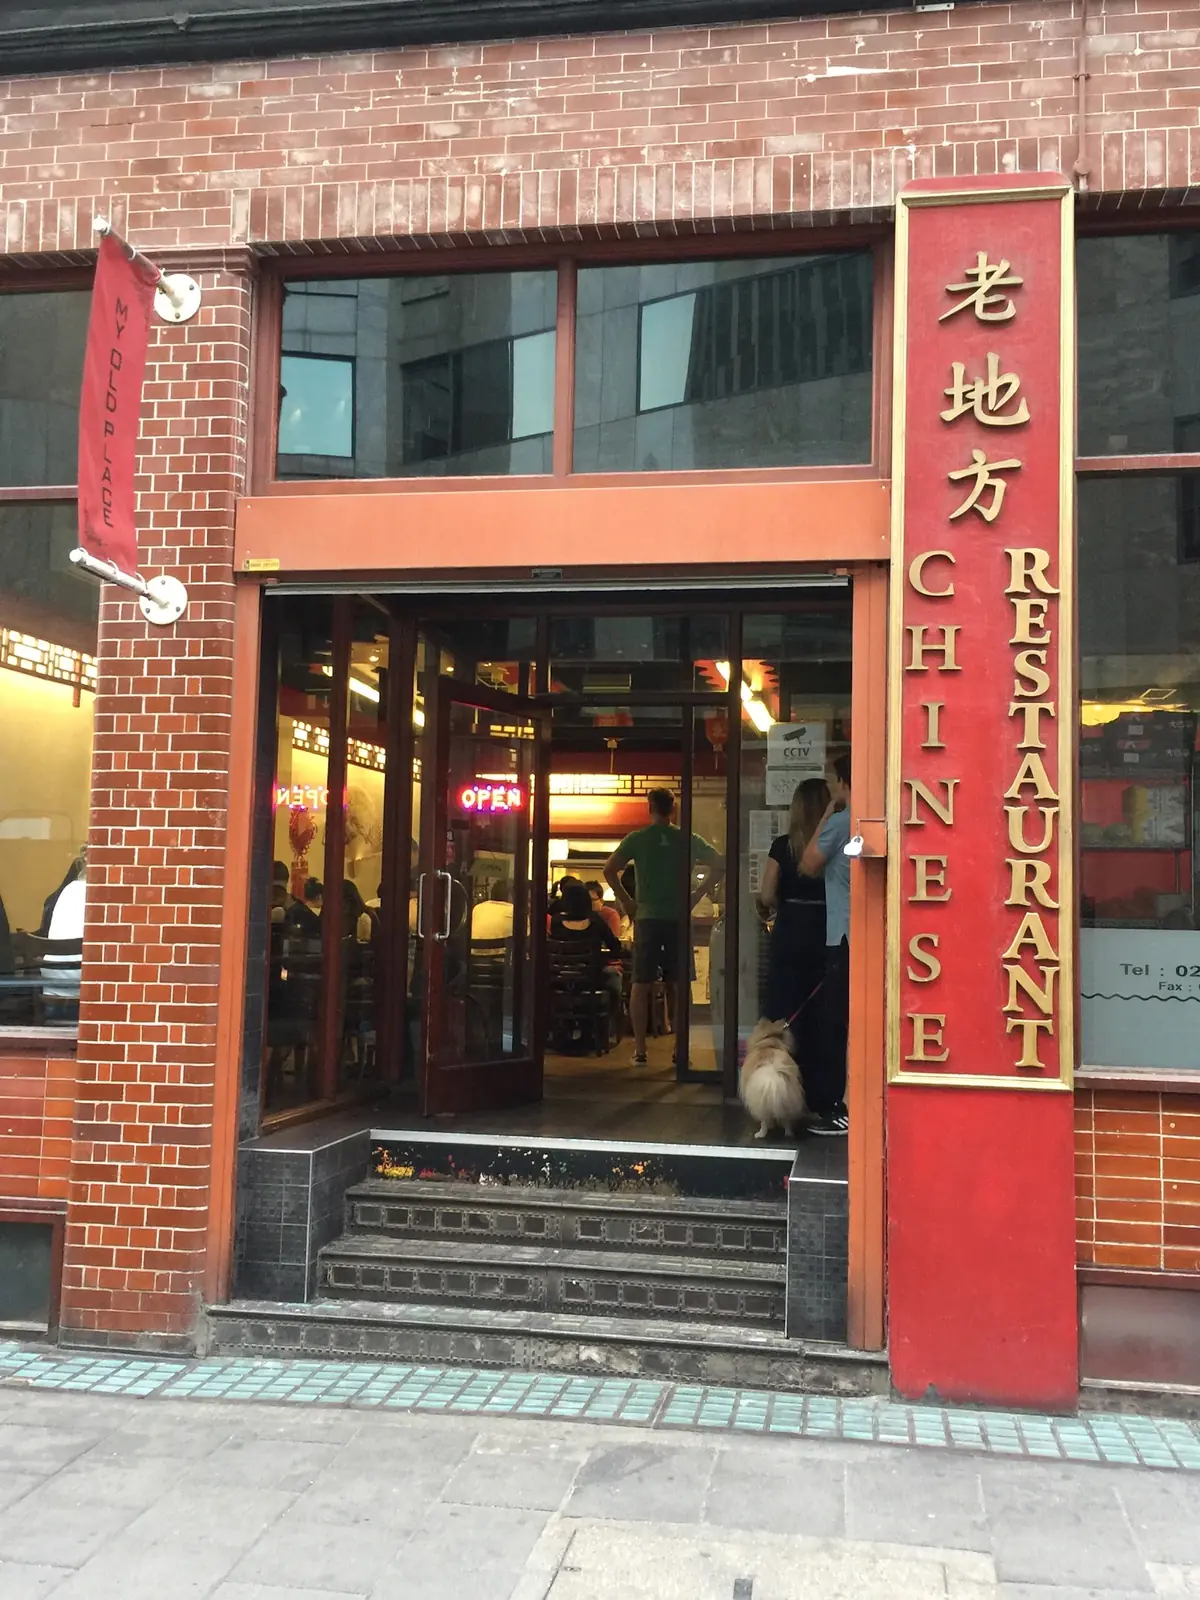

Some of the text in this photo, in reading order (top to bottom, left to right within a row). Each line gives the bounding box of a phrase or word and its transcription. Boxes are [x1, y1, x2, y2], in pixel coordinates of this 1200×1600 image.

[101, 296, 129, 528] MY OLD PLACE
[938, 250, 1031, 523] 老地方
[461, 787, 521, 809] OPEN
[783, 747, 810, 757] CCTV
[904, 550, 962, 1062] CHINESE
[1002, 548, 1060, 1069] RESTAURANT
[1119, 963, 1149, 976] Tel
[1175, 965, 1200, 977] 02
[1158, 981, 1182, 991] Fax
